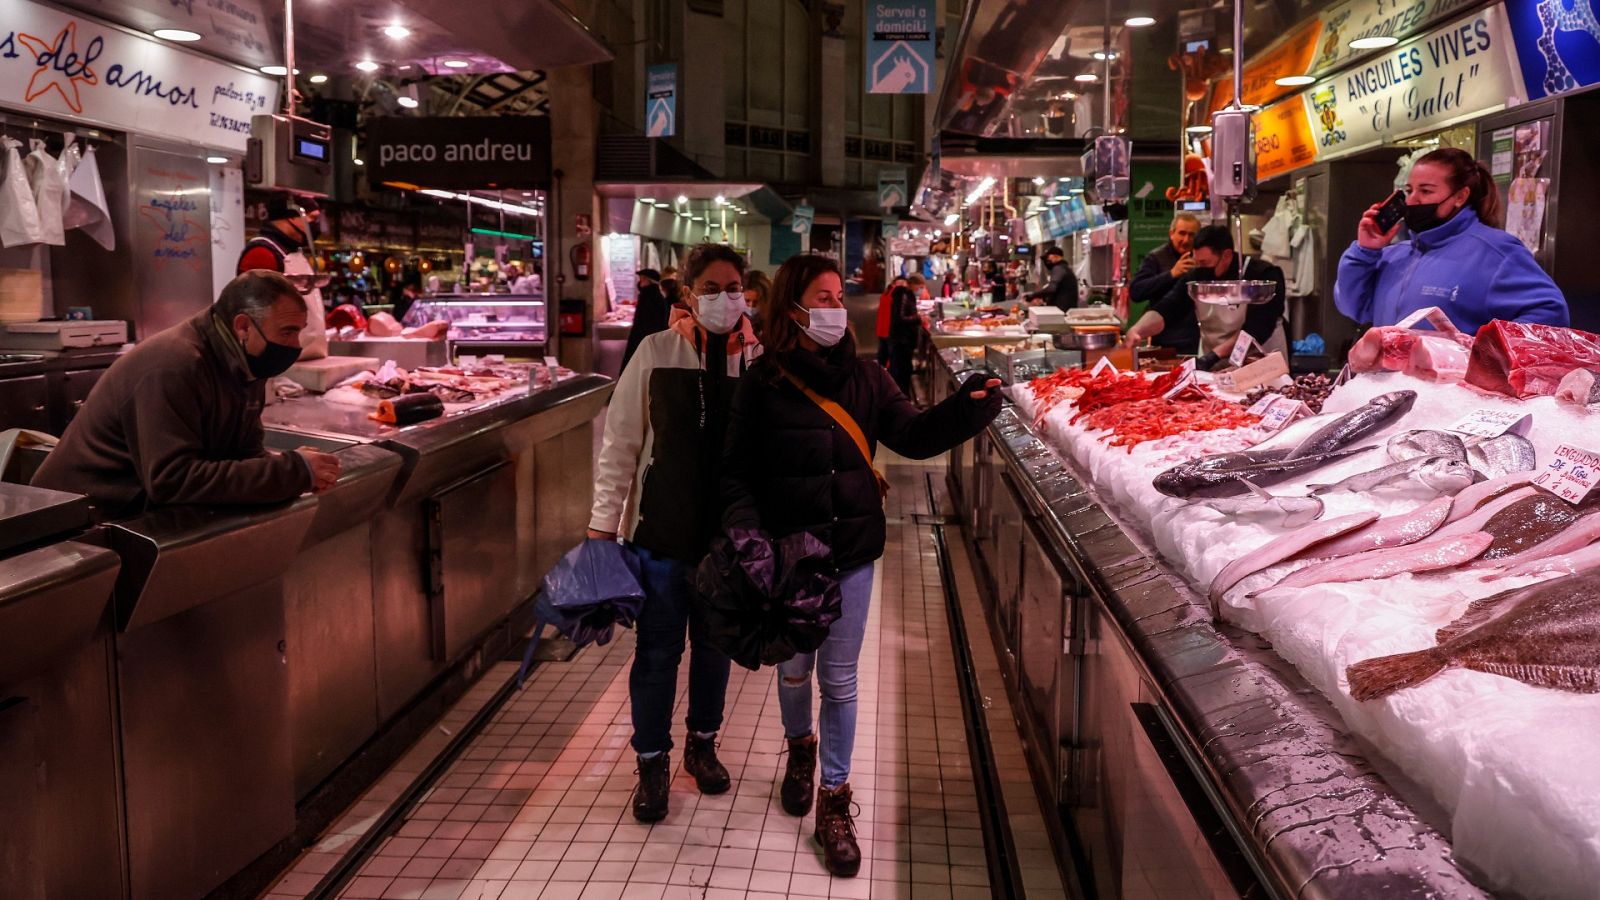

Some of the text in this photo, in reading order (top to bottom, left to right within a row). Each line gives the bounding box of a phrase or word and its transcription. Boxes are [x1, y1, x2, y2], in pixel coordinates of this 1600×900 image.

[876, 4, 927, 17] Servei a
[36, 29, 104, 79] del
[105, 63, 199, 108] amor
[1347, 18, 1491, 102] ANGUILES VIVES
[380, 138, 531, 167] paco andreu
[1549, 458, 1566, 472] DE
